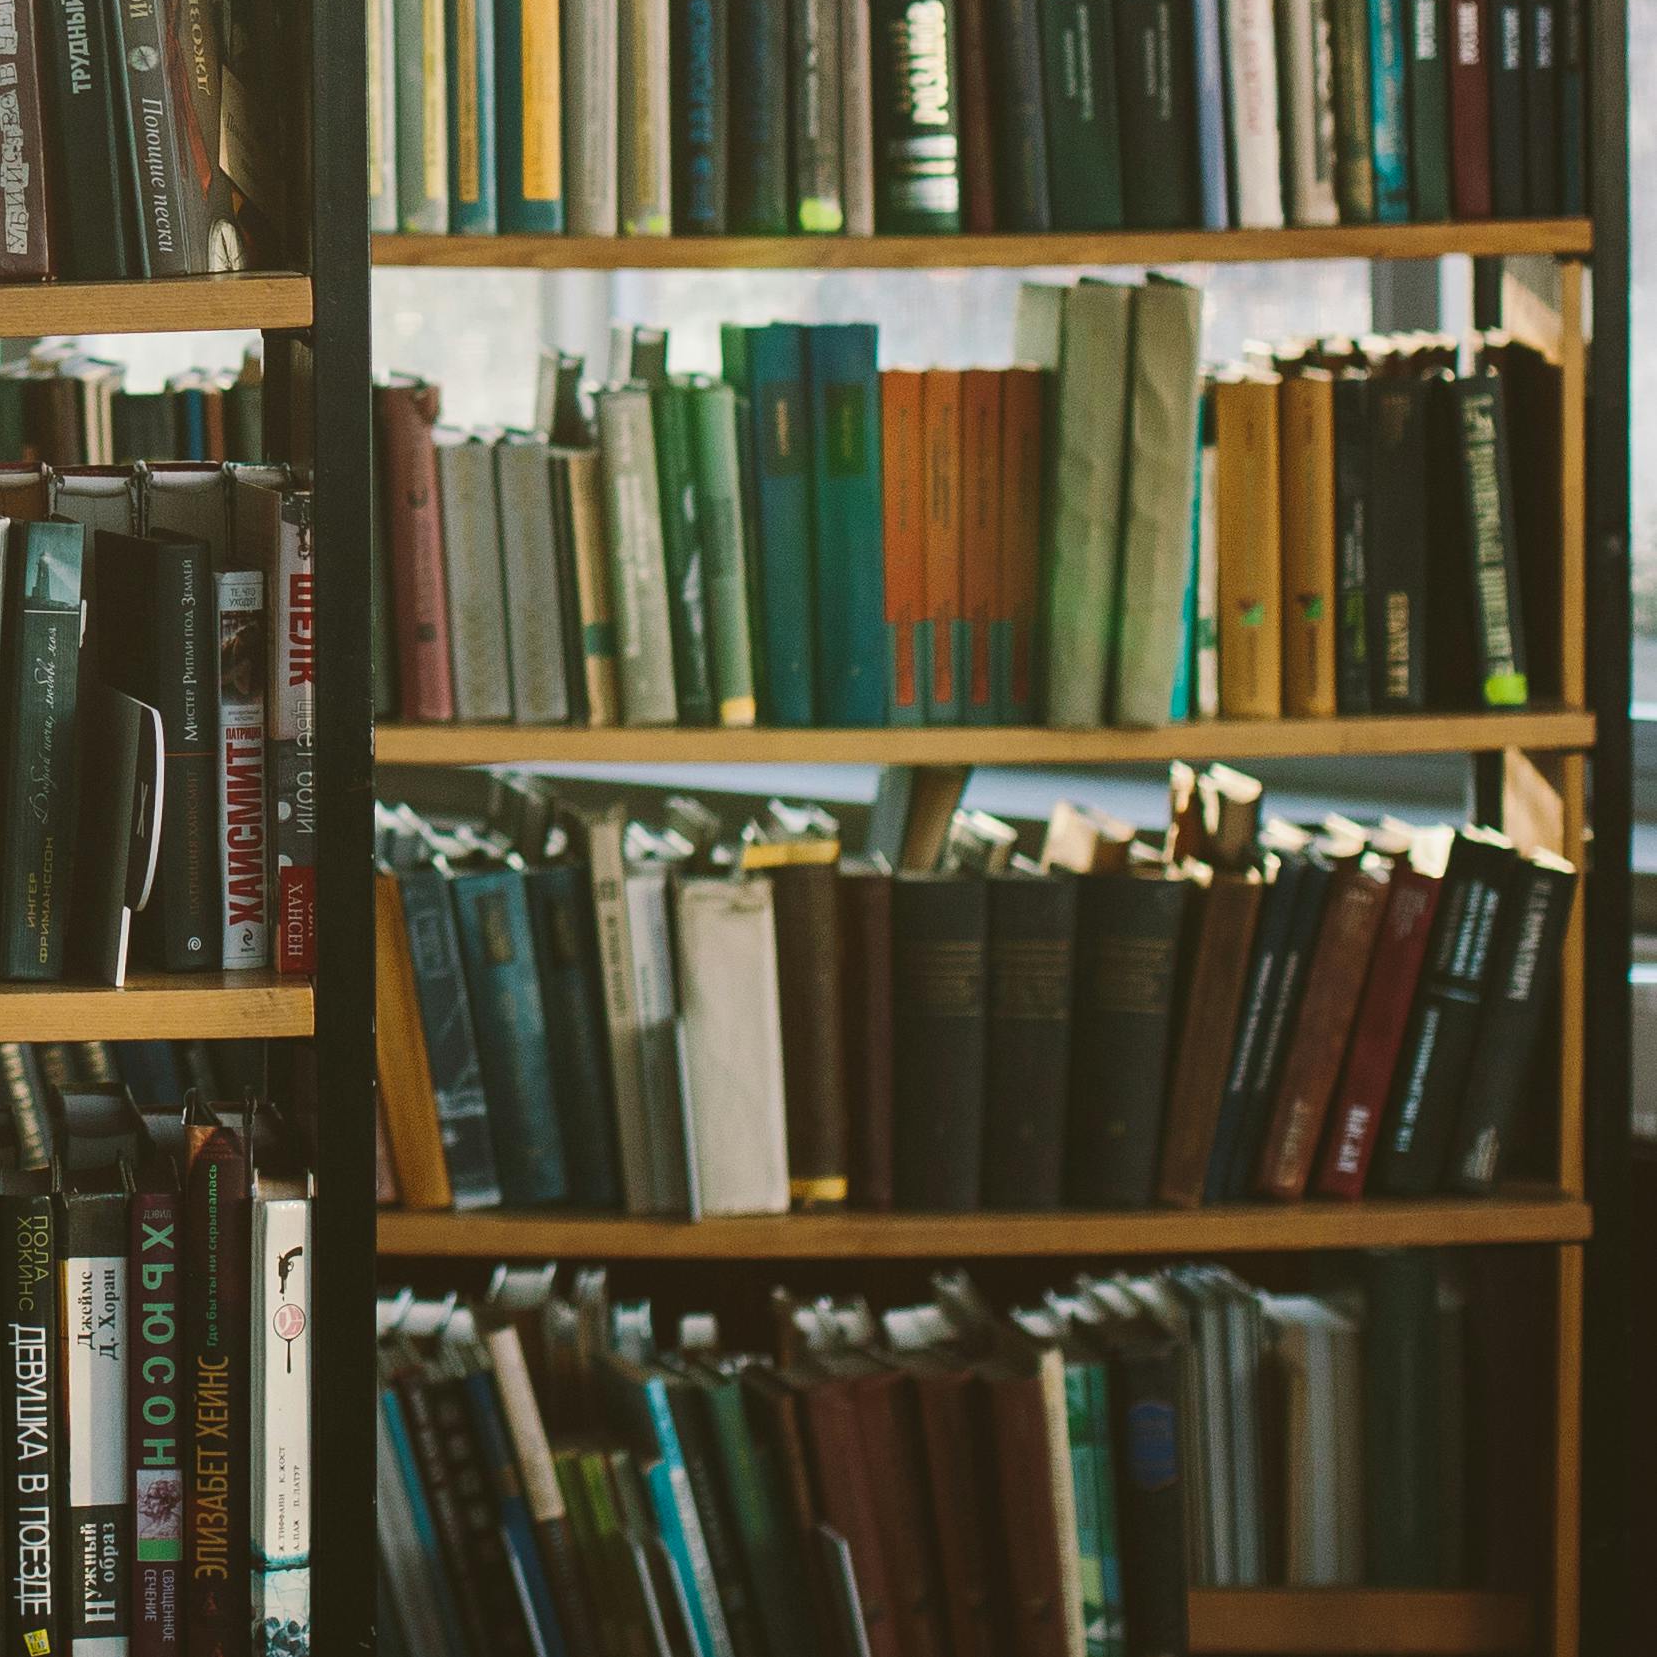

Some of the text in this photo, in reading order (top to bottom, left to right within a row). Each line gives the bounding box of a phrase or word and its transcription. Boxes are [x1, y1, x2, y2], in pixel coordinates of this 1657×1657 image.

[142, 98, 171, 252] Поющие пески
[26, 873, 38, 929] ИНГЕР
[40, 837, 54, 963] ФРИМАНССОН
[76, 1272, 96, 1349] Джеймс
[8, 1324, 52, 1615] ДЕВУШКА В ПОЕЗДЕ
[98, 1523, 116, 1582] образ
